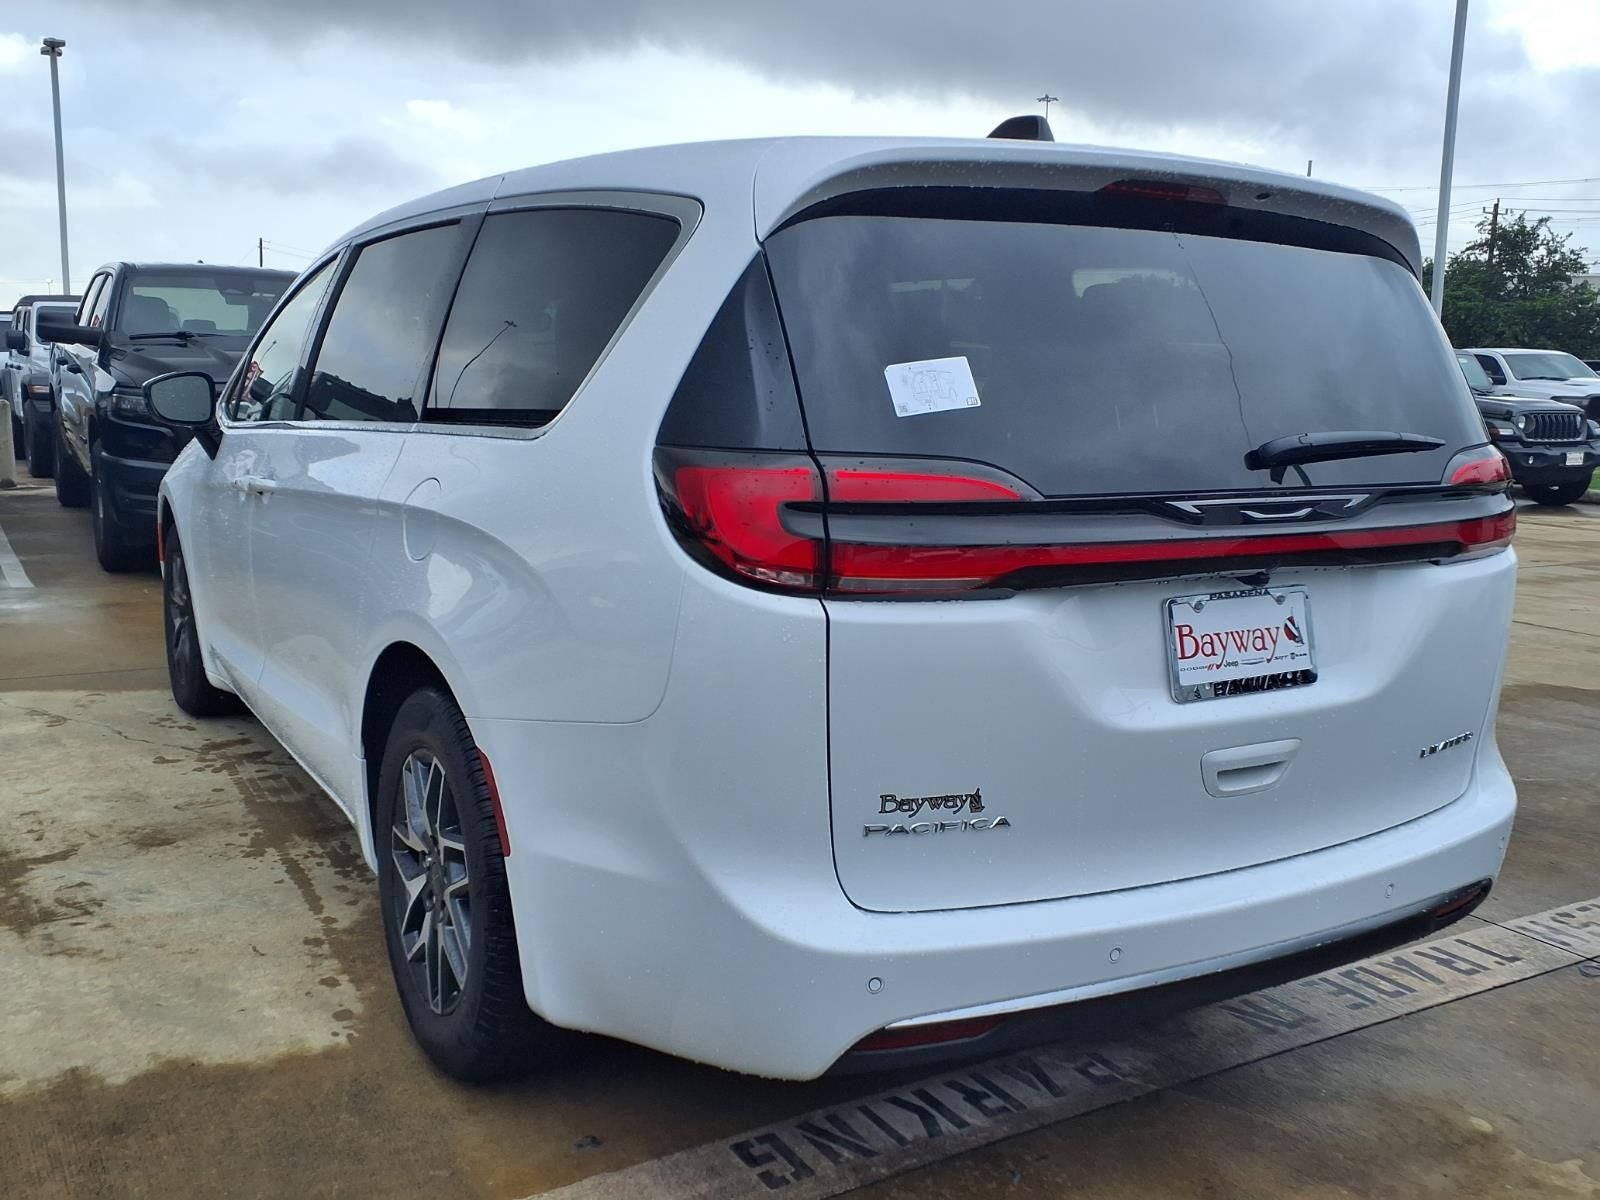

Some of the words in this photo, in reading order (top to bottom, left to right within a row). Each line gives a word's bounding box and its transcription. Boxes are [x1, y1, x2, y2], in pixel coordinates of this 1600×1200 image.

[1209, 588, 1271, 601] PASADENA
[1175, 623, 1280, 670] Bayway
[878, 793, 969, 818] Bayway
[863, 815, 1011, 838] PACIFICA
[730, 1053, 1131, 1190] PARKING
